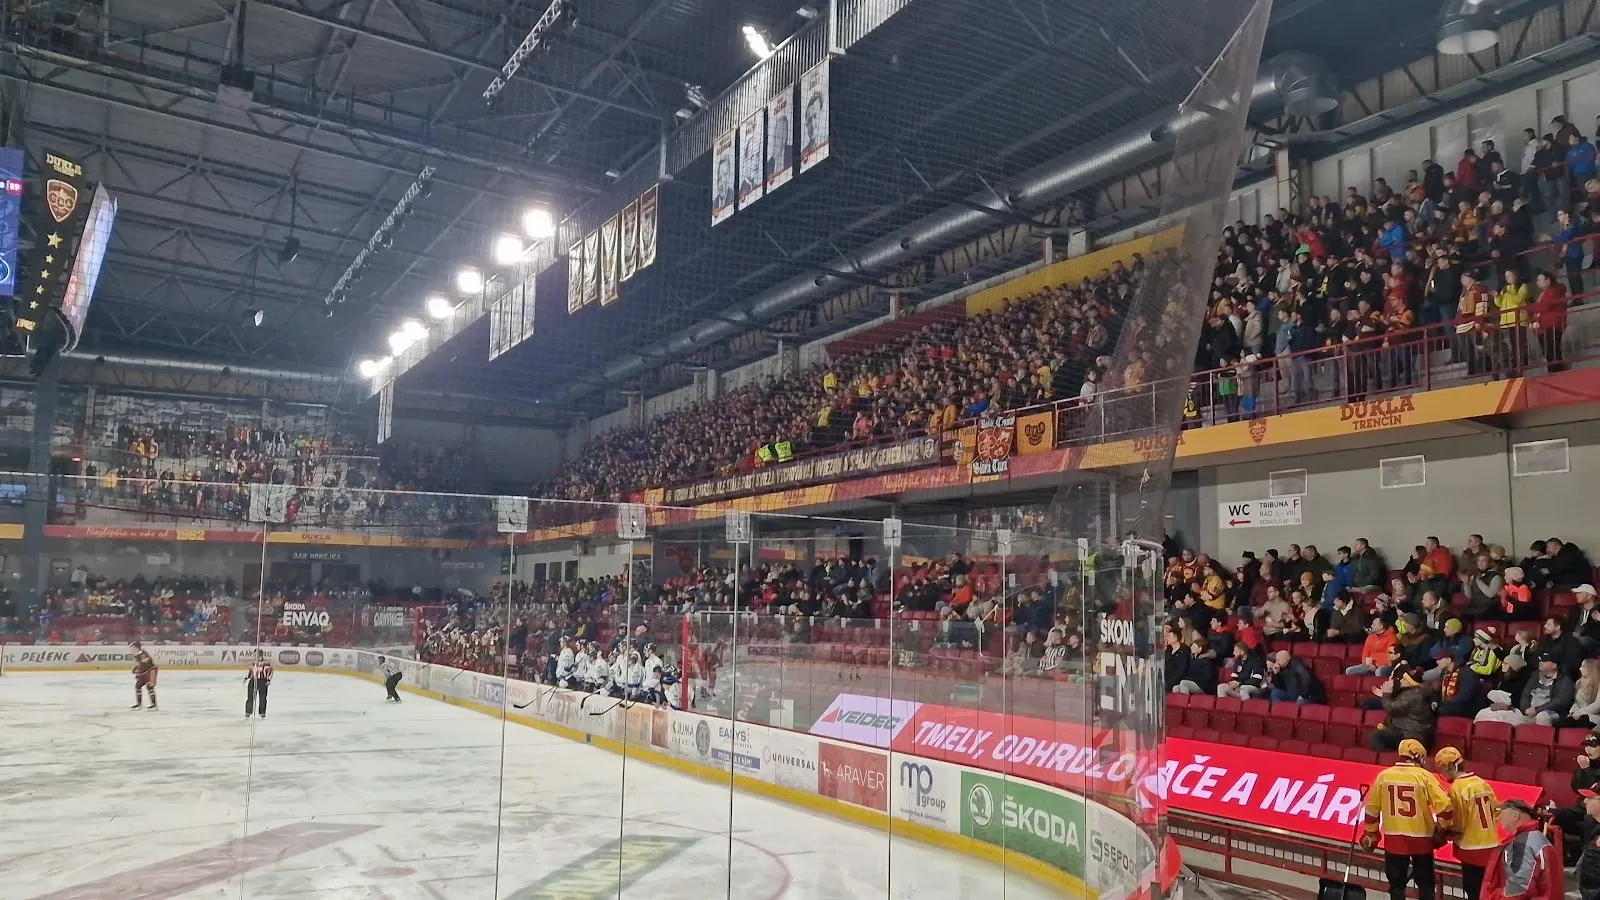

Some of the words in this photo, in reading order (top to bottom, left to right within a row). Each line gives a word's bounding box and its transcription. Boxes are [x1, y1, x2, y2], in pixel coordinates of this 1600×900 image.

[1340, 394, 1415, 421] DUKLA
[1228, 504, 1250, 516] WC
[1293, 499, 1300, 509] F
[284, 601, 306, 611] ŠKODA
[282, 611, 330, 627] ENYAQ
[1100, 612, 1135, 646] ŠKODA
[20, 651, 71, 663] PELLENC
[86, 653, 136, 661] VEIDE
[168, 658, 199, 666] hotel
[239, 650, 272, 658] AMRG
[837, 708, 901, 730] VEIDEC
[772, 752, 816, 771] UNIVERSAL
[836, 763, 885, 791] ARAVER
[912, 720, 993, 760] TMELY,
[1221, 772, 1259, 806] A
[1259, 773, 1366, 826] NÁR
[900, 761, 933, 806] mp
[921, 795, 946, 812] group
[1387, 784, 1417, 818] 15
[1001, 795, 1080, 852] ŠKODA
